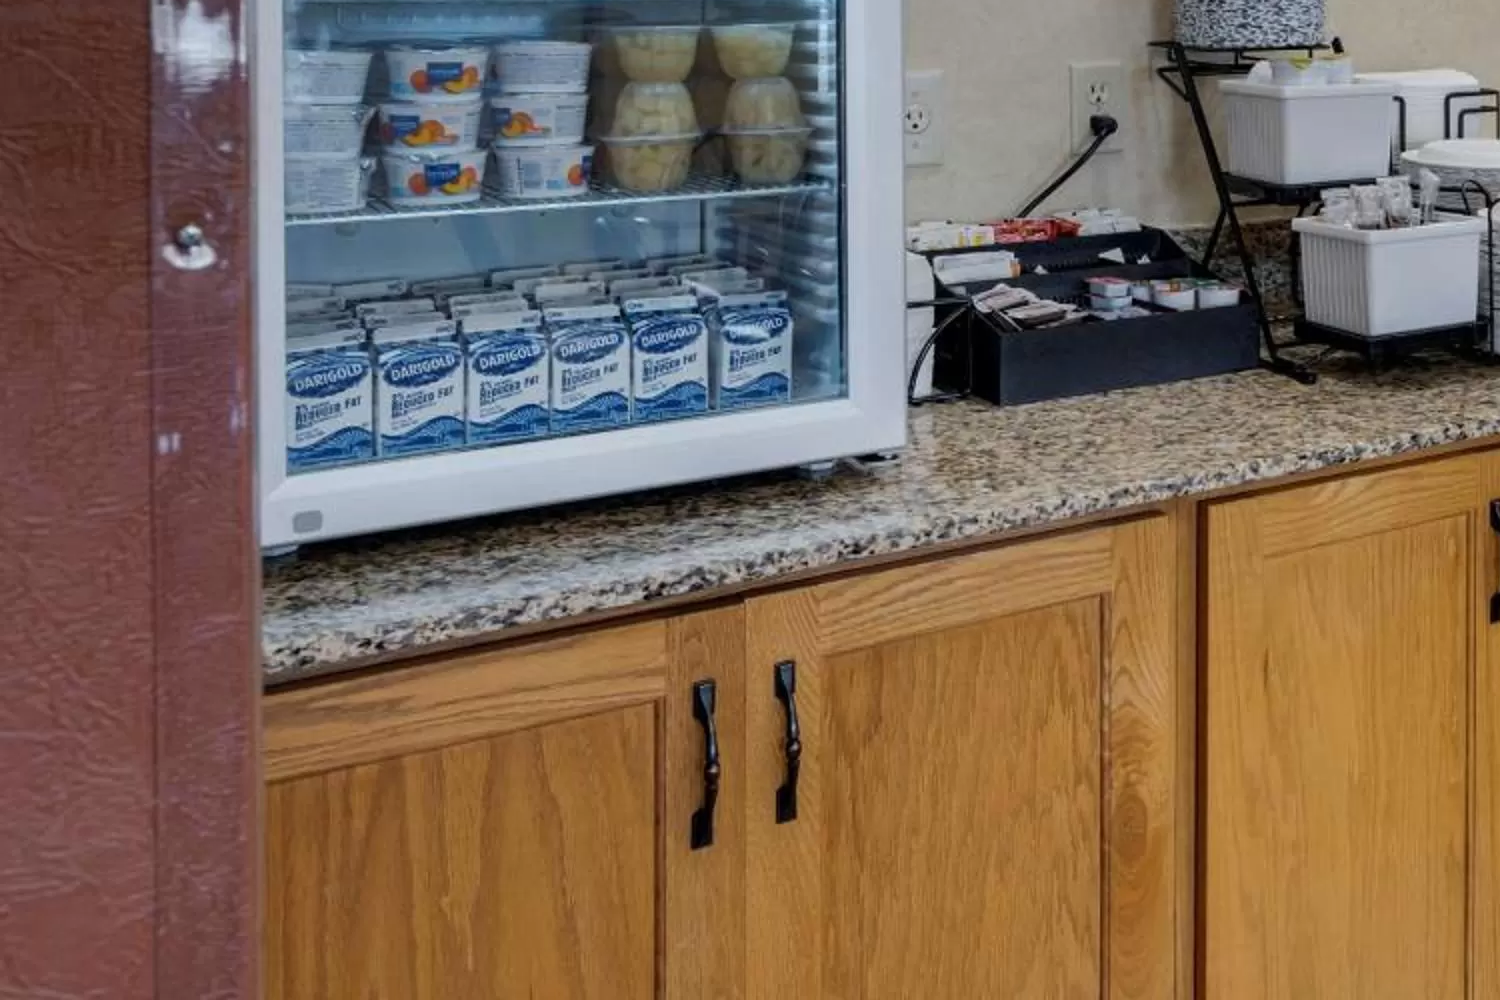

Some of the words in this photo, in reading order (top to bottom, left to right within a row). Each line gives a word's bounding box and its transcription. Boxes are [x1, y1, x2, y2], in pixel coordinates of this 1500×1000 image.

[561, 334, 619, 357] DARIGOLD
[641, 323, 697, 348] DARIGOLD
[391, 354, 456, 382] DARIGOLD
[480, 344, 540, 370] DARIGOLD
[295, 363, 363, 392] DARIGOLD
